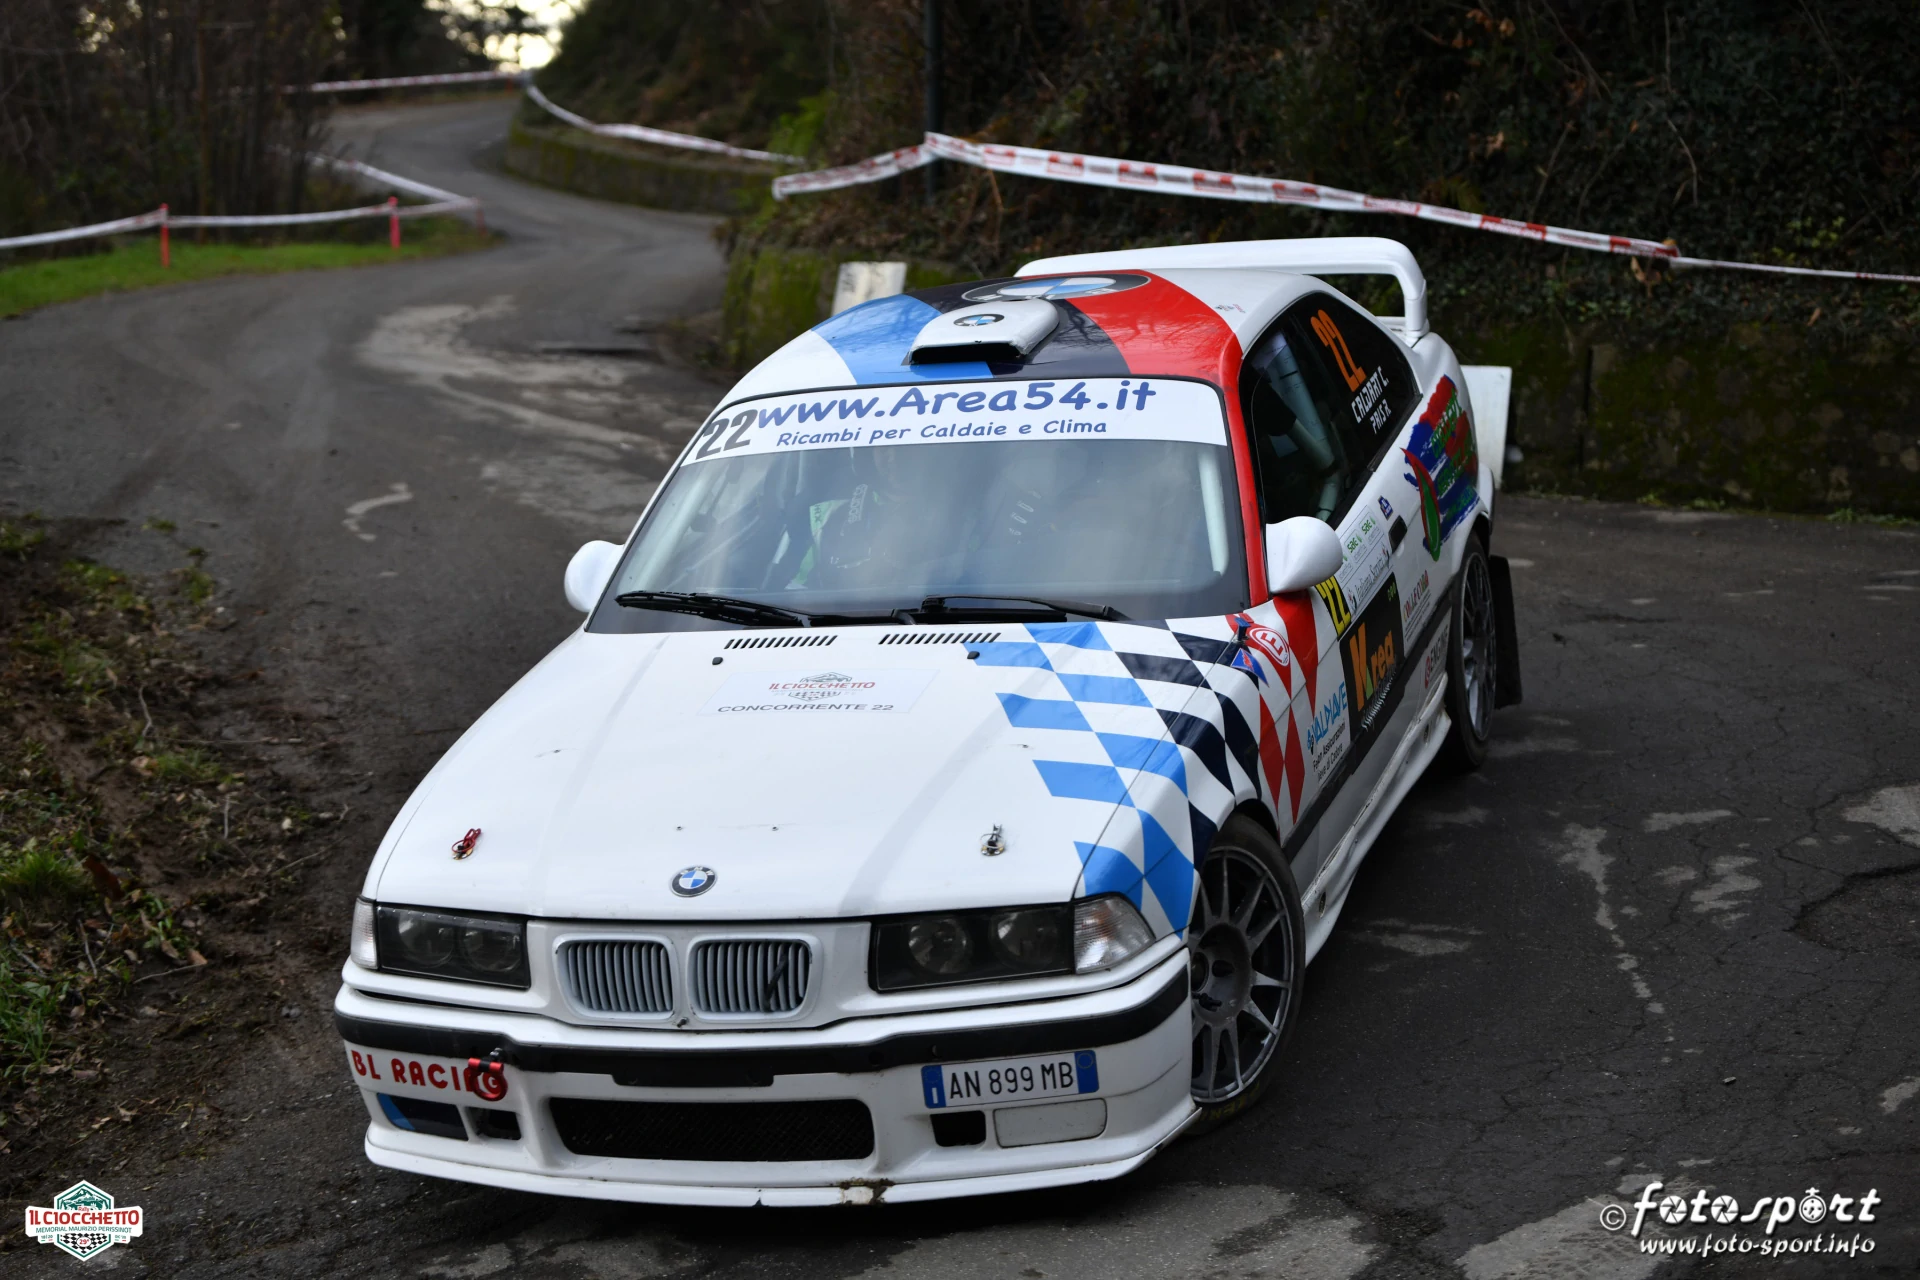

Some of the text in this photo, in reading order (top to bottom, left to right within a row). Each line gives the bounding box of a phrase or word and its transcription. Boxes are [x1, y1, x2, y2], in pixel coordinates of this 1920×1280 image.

[1310, 309, 1367, 392] 22
[758, 380, 1157, 429] www.Area54.it
[696, 409, 760, 460] 22
[776, 417, 1108, 447] Ricambi per Caldaie e Clima
[717, 703, 894, 713] CONCORRENTE 22
[351, 1050, 381, 1080] BL
[949, 1061, 1074, 1099] AN 899 MB
